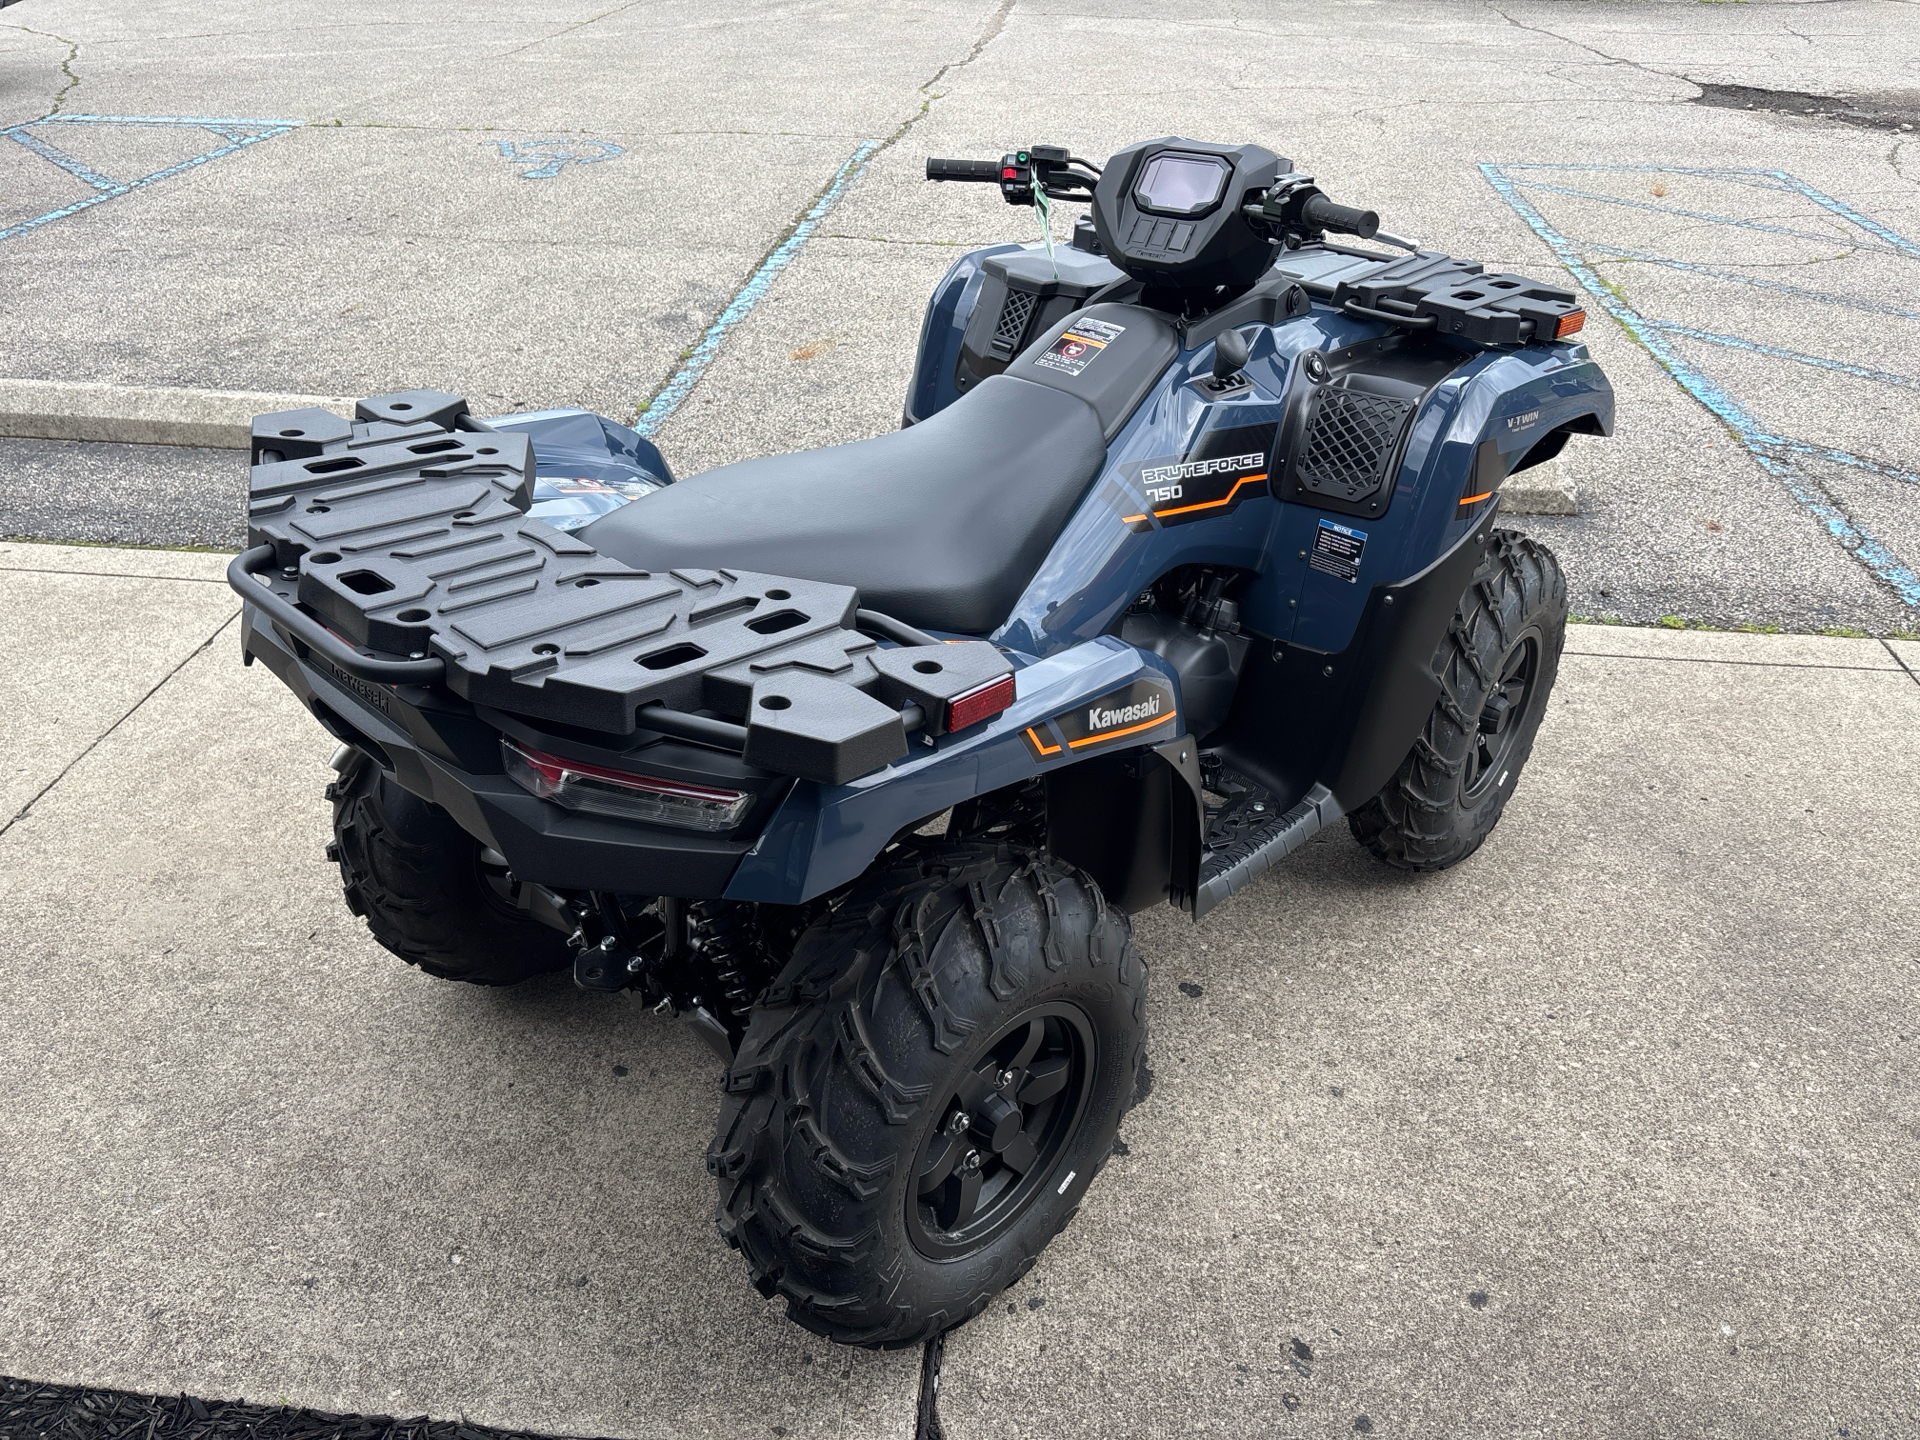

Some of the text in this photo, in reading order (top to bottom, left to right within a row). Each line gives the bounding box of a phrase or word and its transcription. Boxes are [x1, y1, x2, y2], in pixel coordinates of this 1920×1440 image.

[1507, 410, 1539, 428] V-TWIN
[1146, 484, 1182, 502] 750
[1333, 524, 1352, 536] NOTICE
[1089, 693, 1160, 731] Kawasaki
